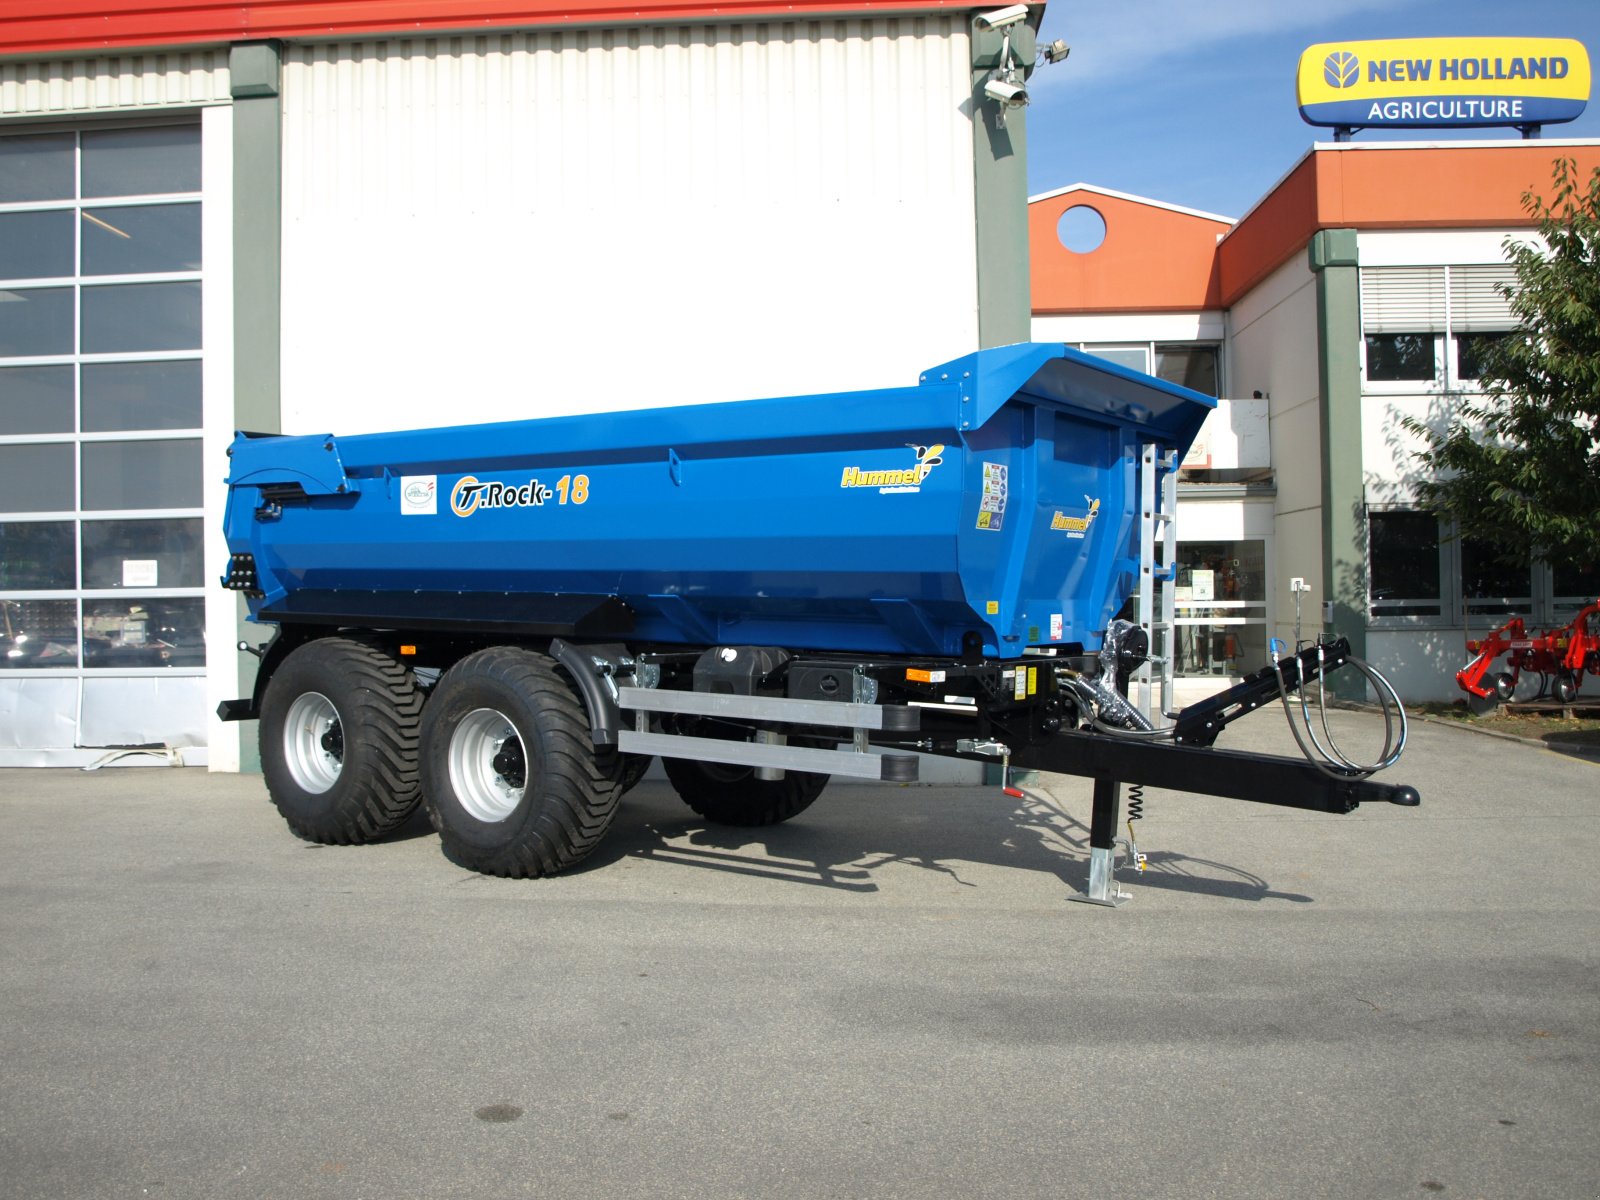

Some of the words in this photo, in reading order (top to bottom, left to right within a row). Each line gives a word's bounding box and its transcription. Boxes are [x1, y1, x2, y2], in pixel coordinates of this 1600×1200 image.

[1368, 59, 1432, 82] NEW
[1439, 57, 1568, 80] HOLLAND
[1368, 100, 1522, 119] AGRICULTURE
[841, 464, 921, 487] Hummel
